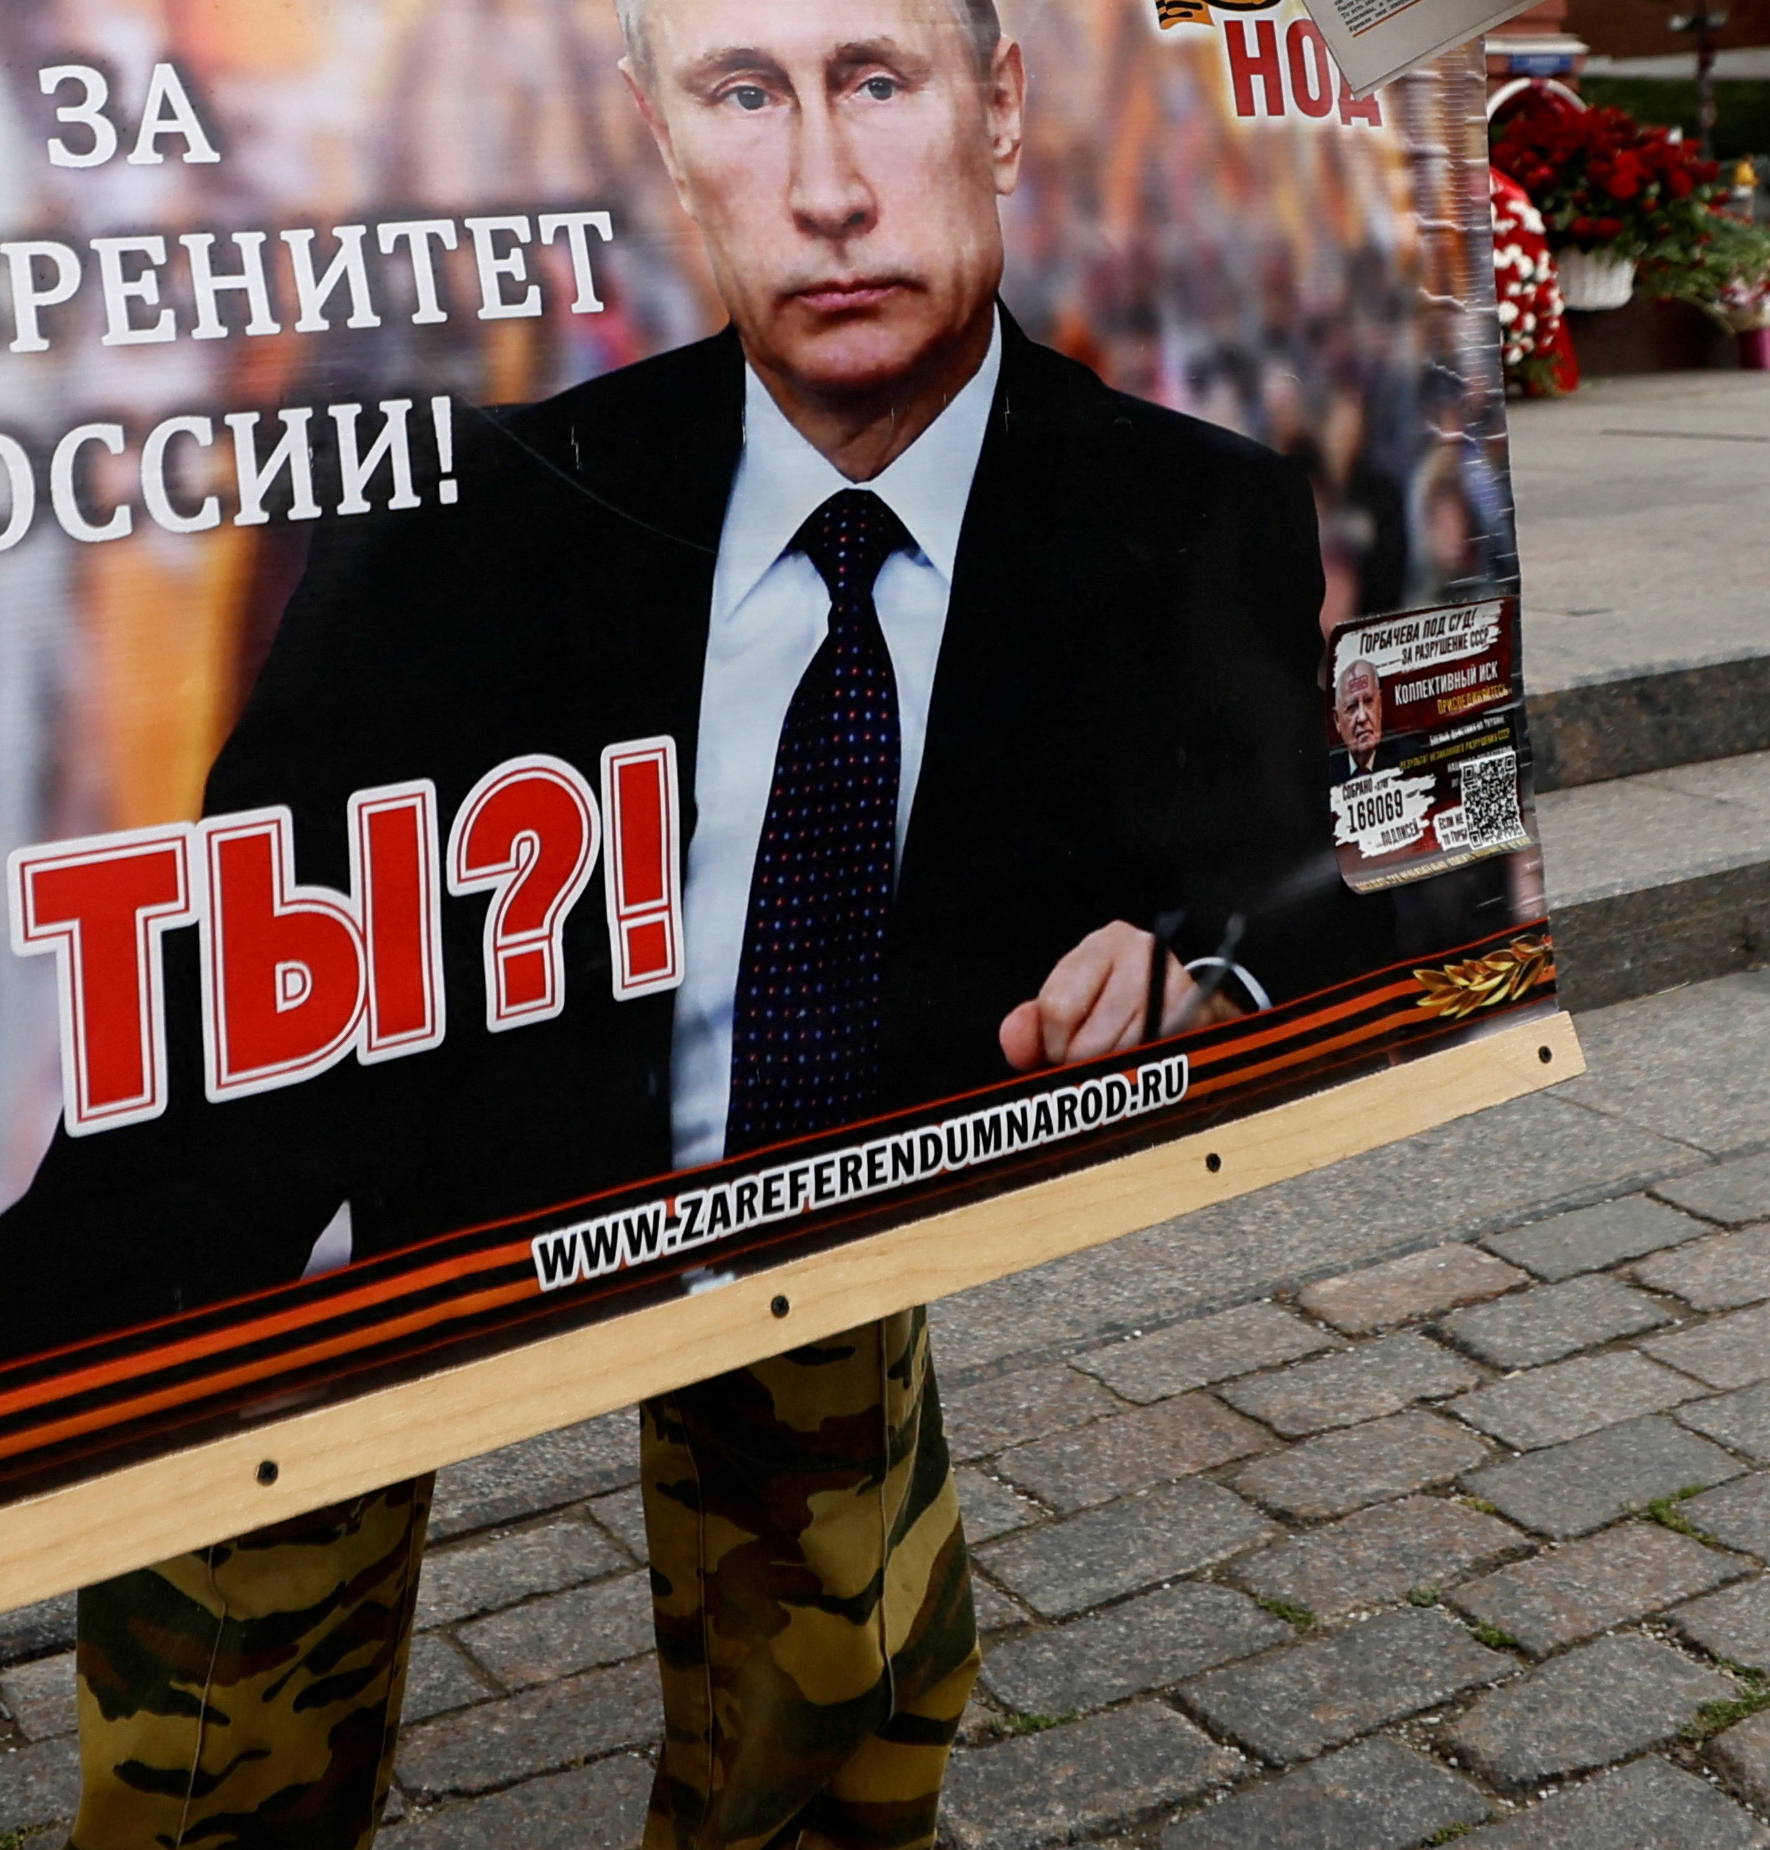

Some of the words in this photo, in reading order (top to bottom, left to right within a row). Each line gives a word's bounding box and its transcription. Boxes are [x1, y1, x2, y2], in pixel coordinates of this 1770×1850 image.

[38, 62, 221, 168] ЗА
[1359, 620, 1420, 656] ГОРБАЧЕВА
[1422, 614, 1446, 639] ПОД
[1448, 607, 1478, 631] СУД!
[1401, 649, 1413, 666] ЗА
[1415, 636, 1468, 662] РАЗРУШЕНИЕ
[1348, 789, 1404, 834] 168069
[6, 733, 684, 1137] ТЫ?!
[531, 1054, 1190, 1291] WWW.ZAREFERENDUMNAROD.RU
